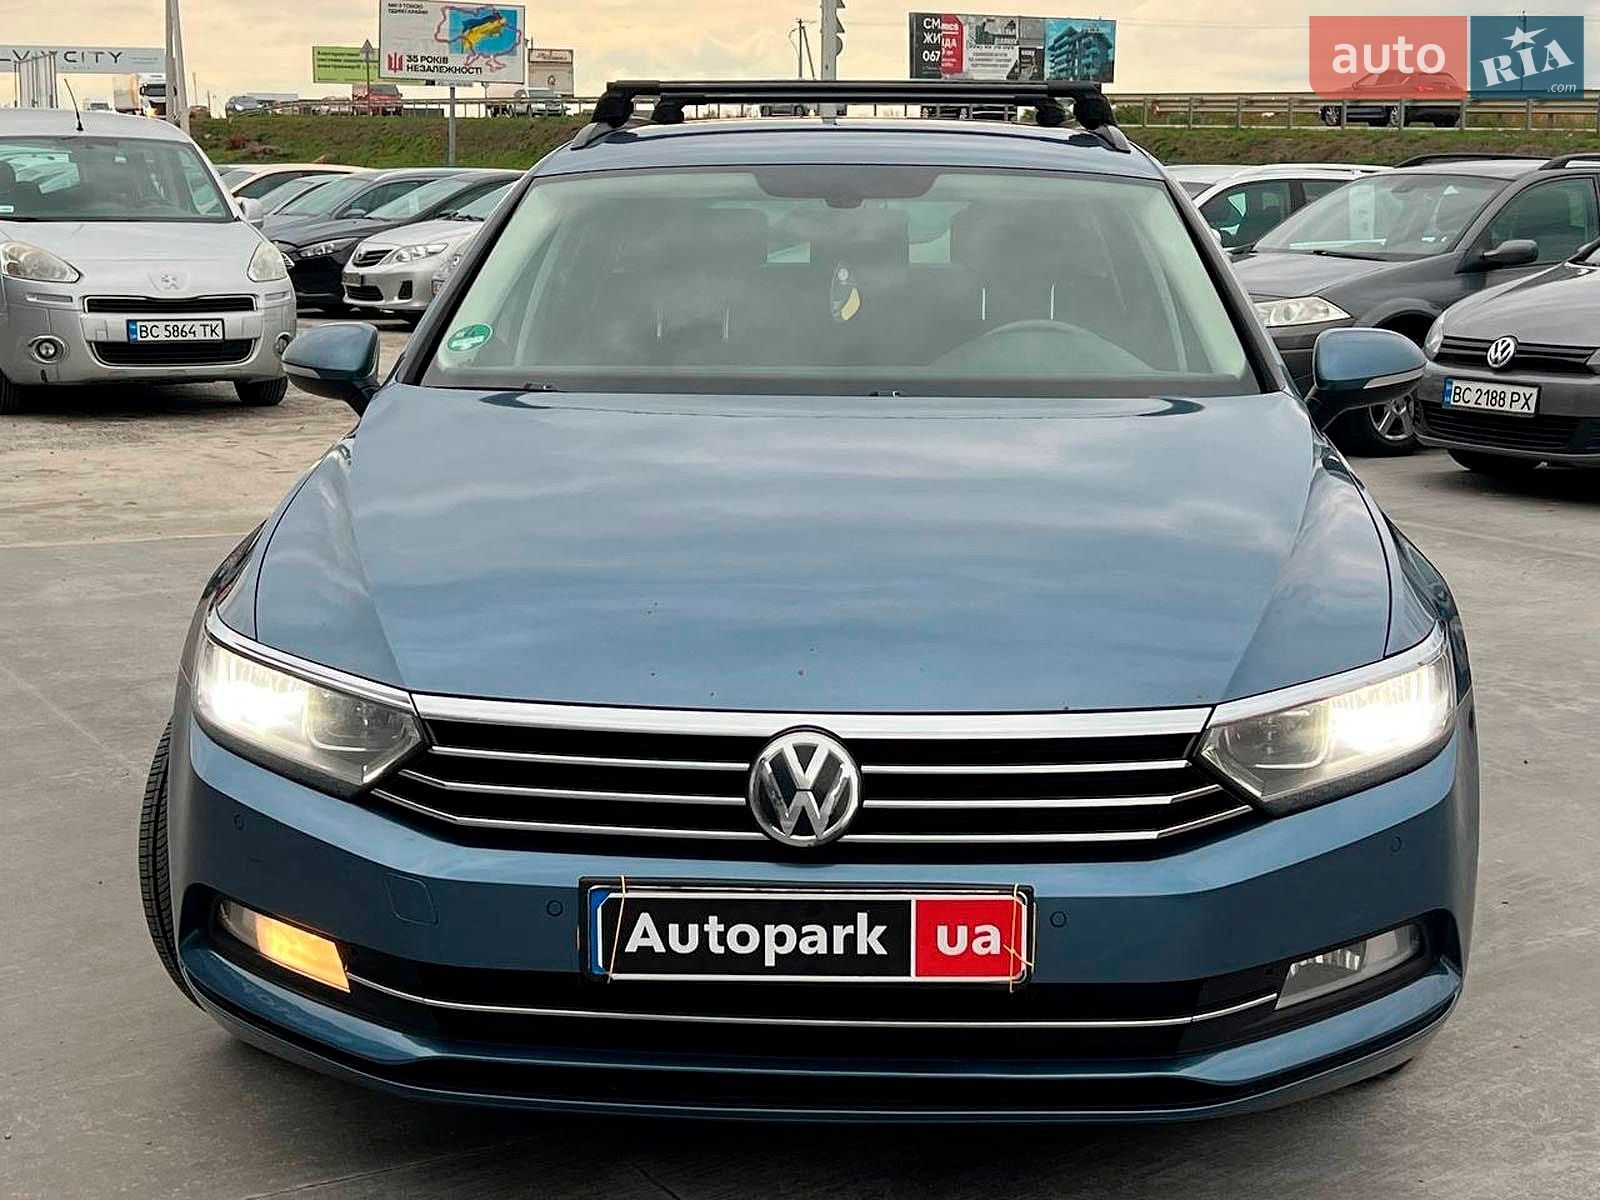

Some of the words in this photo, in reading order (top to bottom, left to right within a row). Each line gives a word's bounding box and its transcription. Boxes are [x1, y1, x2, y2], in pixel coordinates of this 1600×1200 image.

[420, 55, 449, 65] РОКІВ
[406, 64, 482, 75] НЕЗАЛЕЖНОСТІ
[139, 324, 160, 339] BC
[164, 324, 197, 338] 5864
[200, 323, 221, 338] TK
[1453, 385, 1472, 404] BC
[1474, 388, 1506, 408] 2188
[1509, 391, 1534, 411] PX
[624, 912, 888, 967] Autopark
[936, 924, 1001, 955] ua
